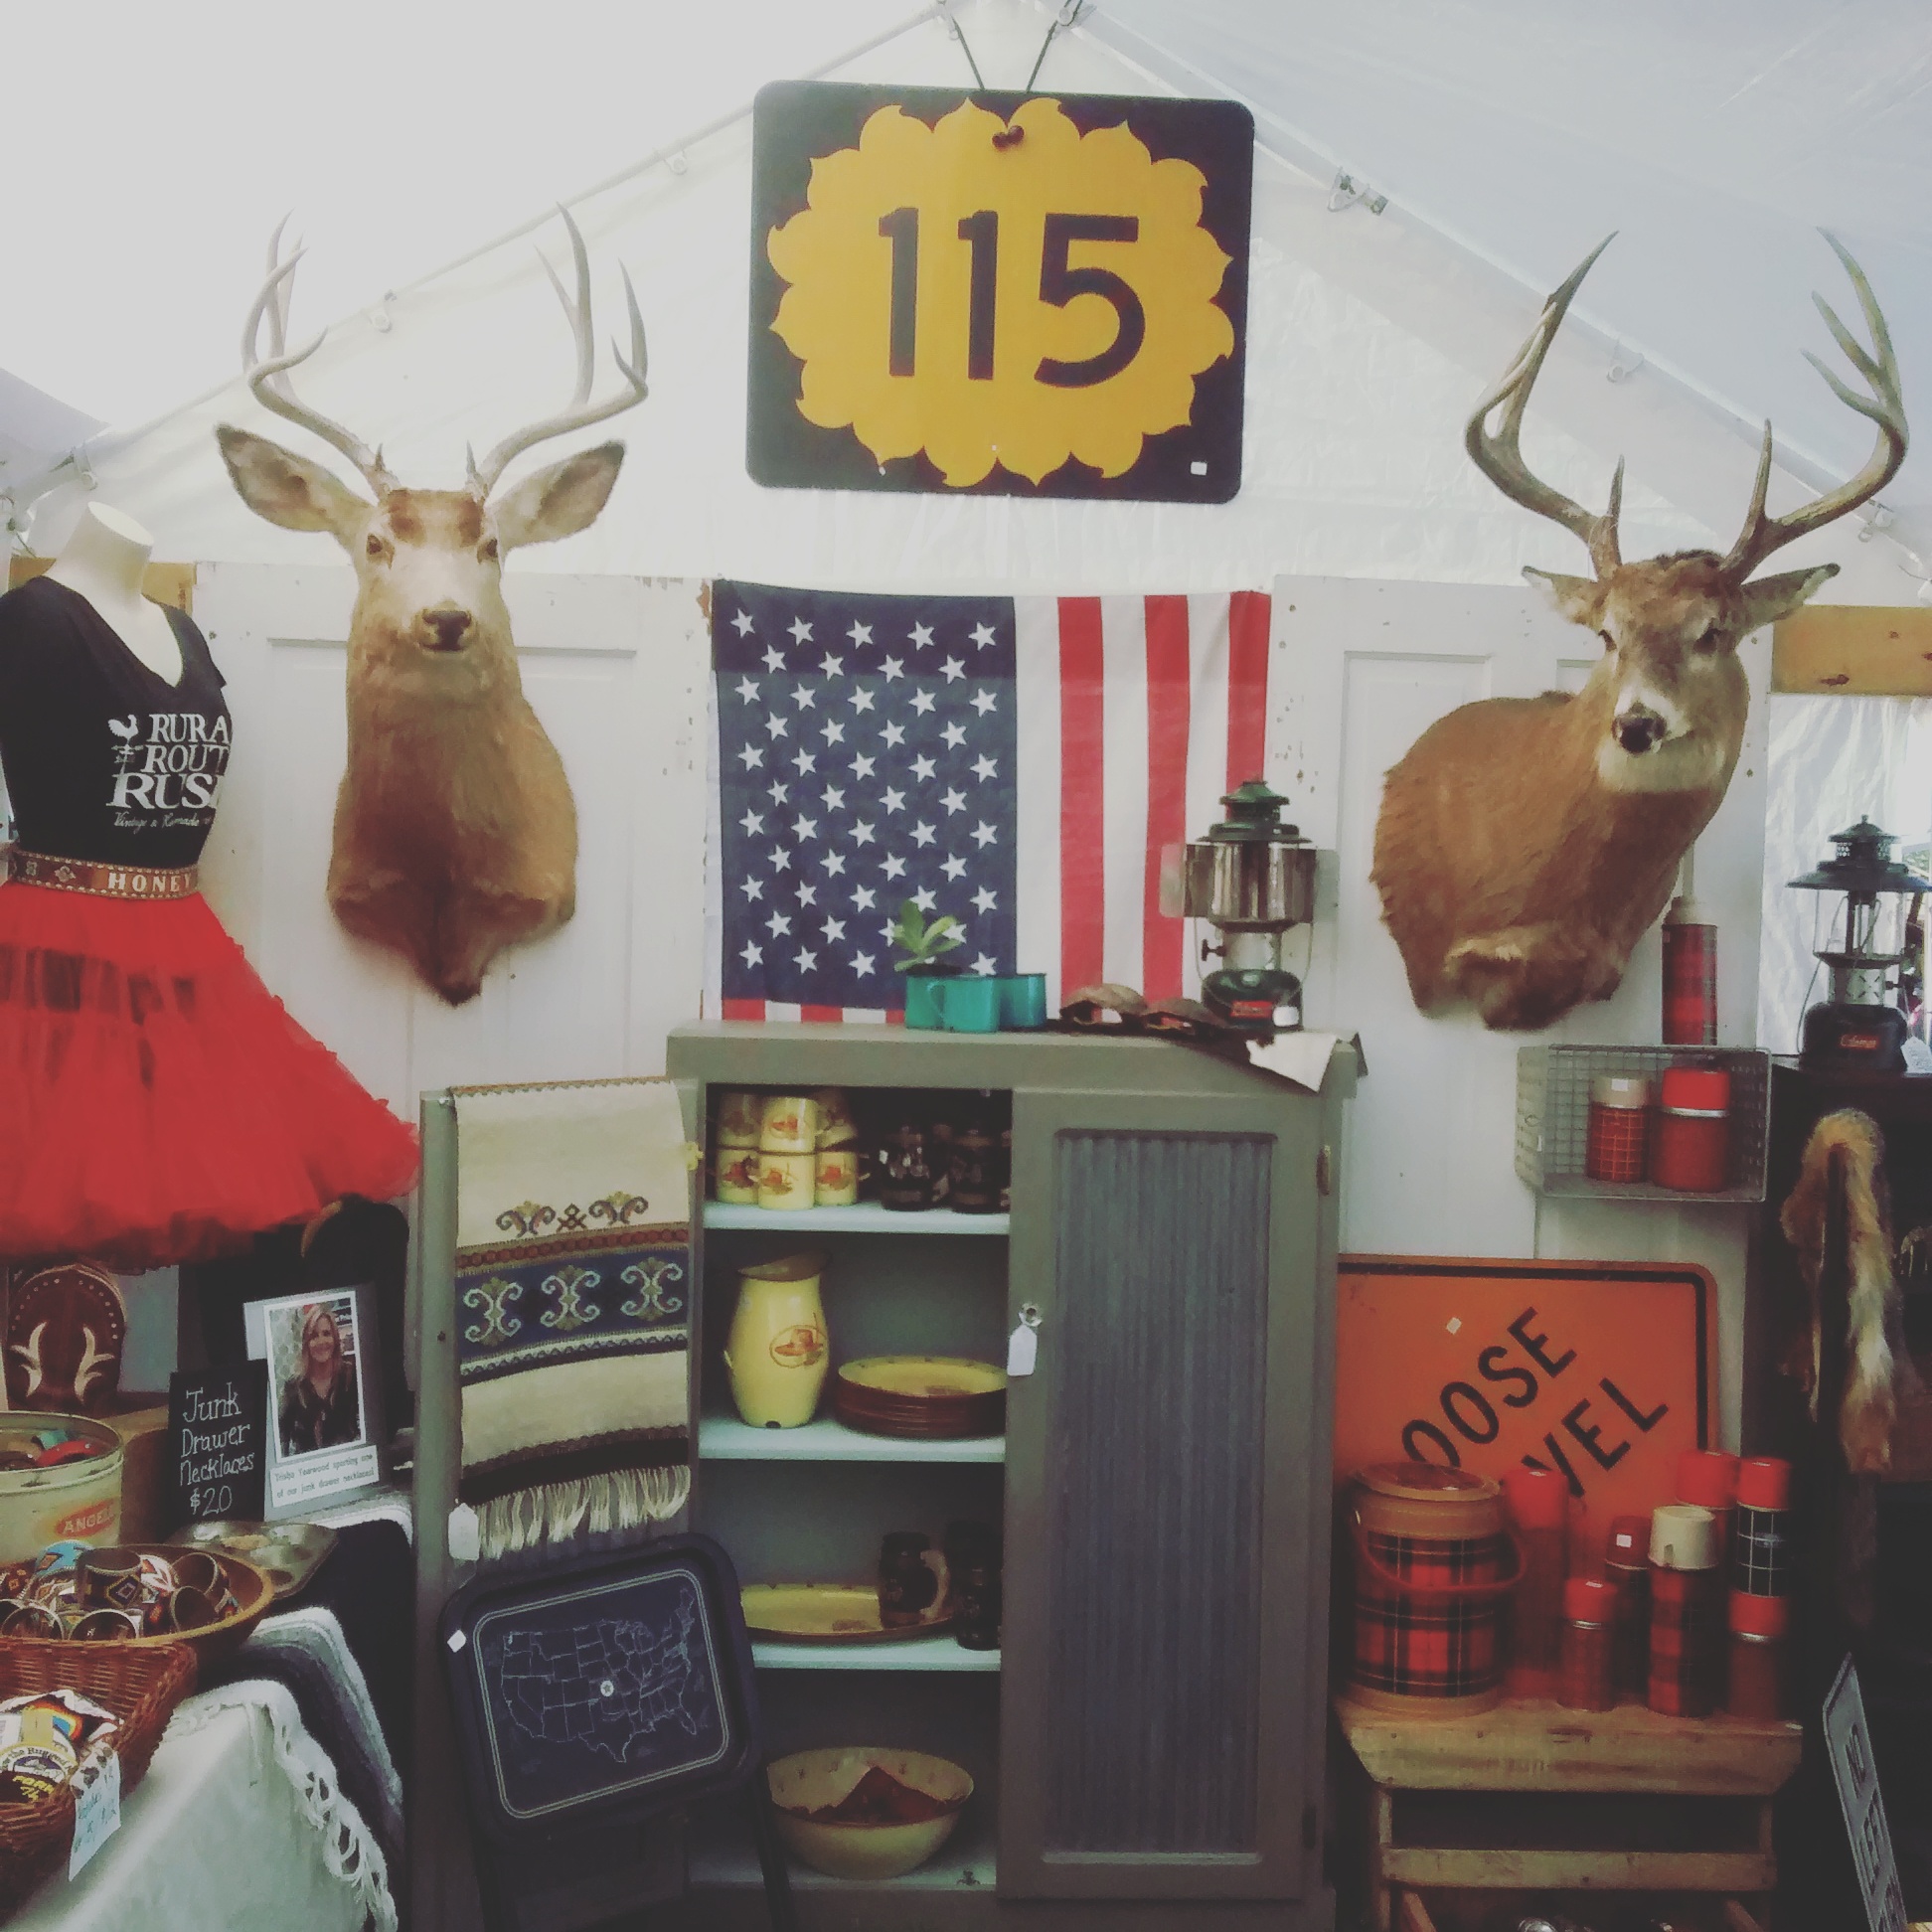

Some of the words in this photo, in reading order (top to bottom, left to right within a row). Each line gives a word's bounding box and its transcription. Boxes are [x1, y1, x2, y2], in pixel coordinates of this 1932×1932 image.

[879, 207, 1146, 390] 115
[107, 871, 191, 892] HONEY
[182, 1381, 242, 1423] Junk
[180, 1423, 250, 1458] Drawer
[189, 1485, 233, 1517] $20
